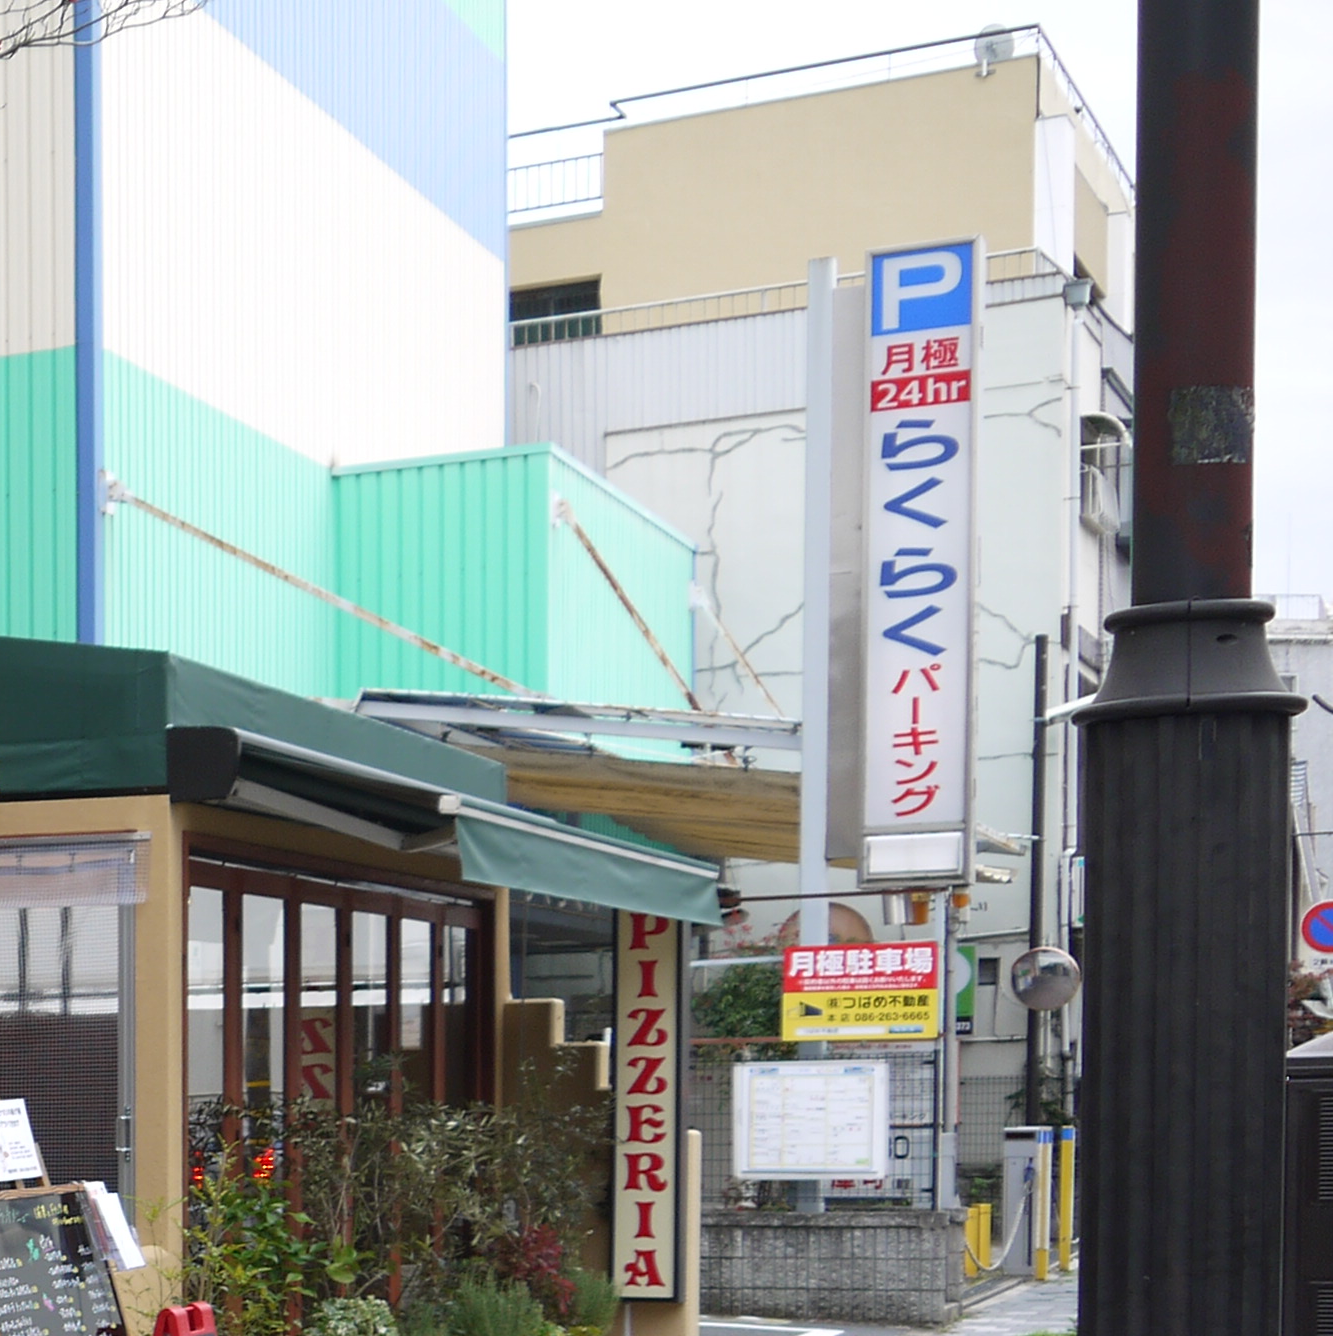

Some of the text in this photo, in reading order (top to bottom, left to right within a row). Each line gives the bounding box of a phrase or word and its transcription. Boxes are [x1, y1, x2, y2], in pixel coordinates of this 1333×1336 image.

[882, 250, 962, 331] P
[882, 337, 960, 376] 月極
[877, 378, 967, 409] 24hr
[789, 947, 933, 977] 月極駐車場
[854, 1011, 930, 1022] 086-263-6665
[623, 912, 669, 1287] PIZZERIA
